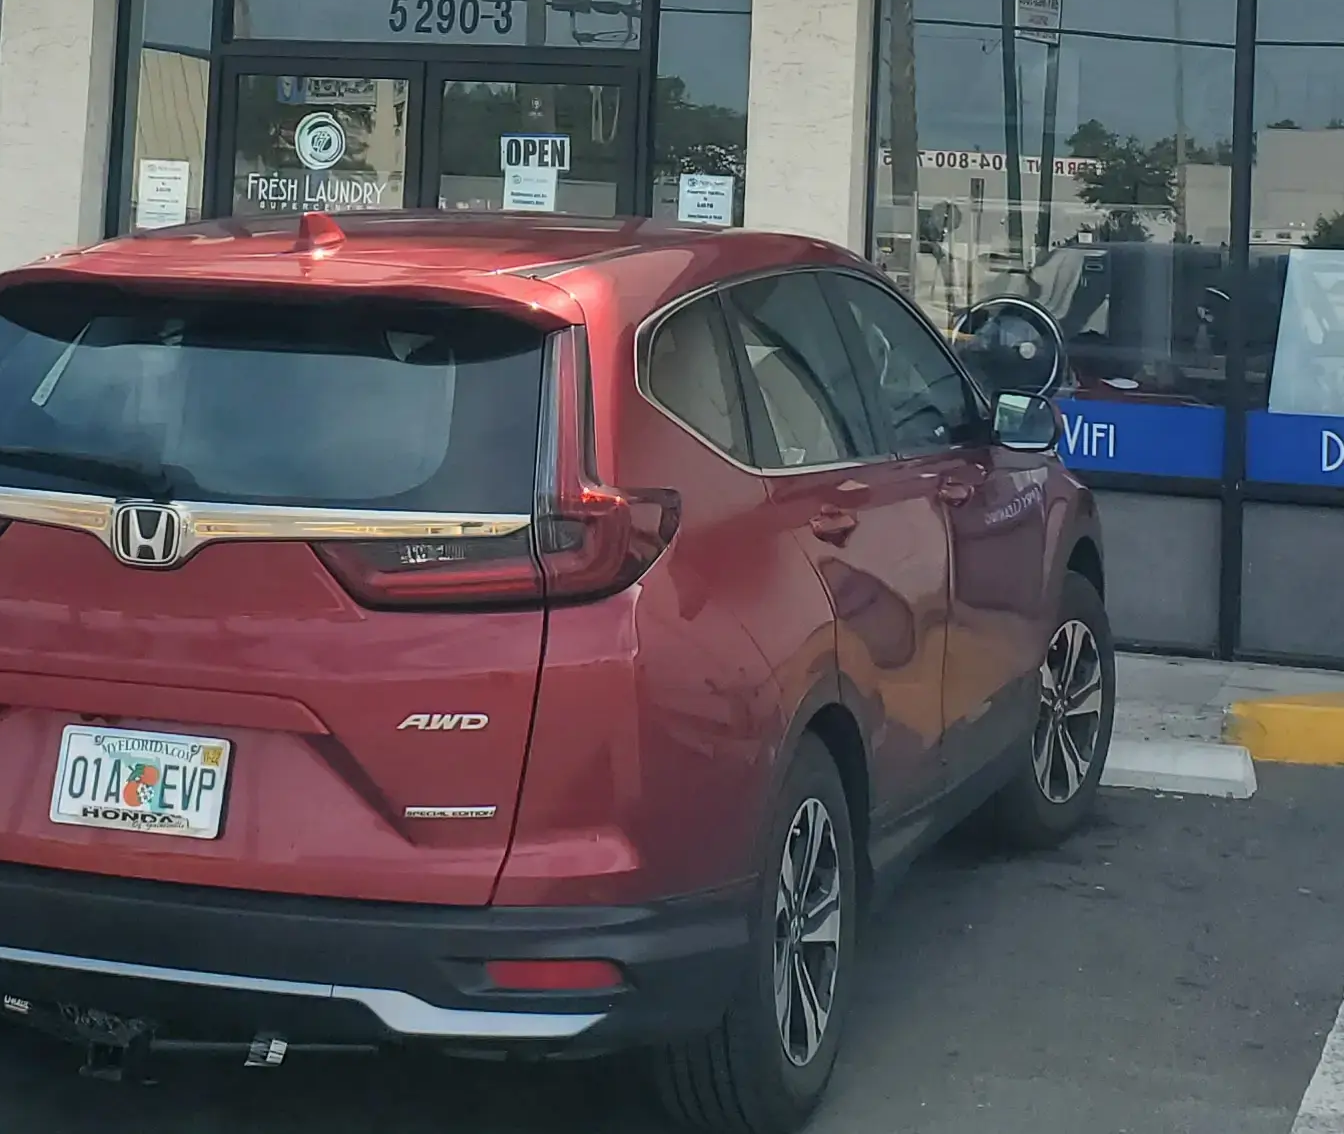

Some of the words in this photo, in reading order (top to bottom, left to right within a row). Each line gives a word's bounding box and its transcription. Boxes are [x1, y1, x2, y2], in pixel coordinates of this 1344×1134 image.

[506, 138, 566, 168] OPEN
[247, 172, 299, 202] FRESH
[304, 173, 388, 205] LAUNDRY
[396, 713, 490, 730] AWD
[82, 807, 174, 824] HONDA
[406, 809, 449, 817] SPECIAL
[452, 809, 494, 817] EDITION
